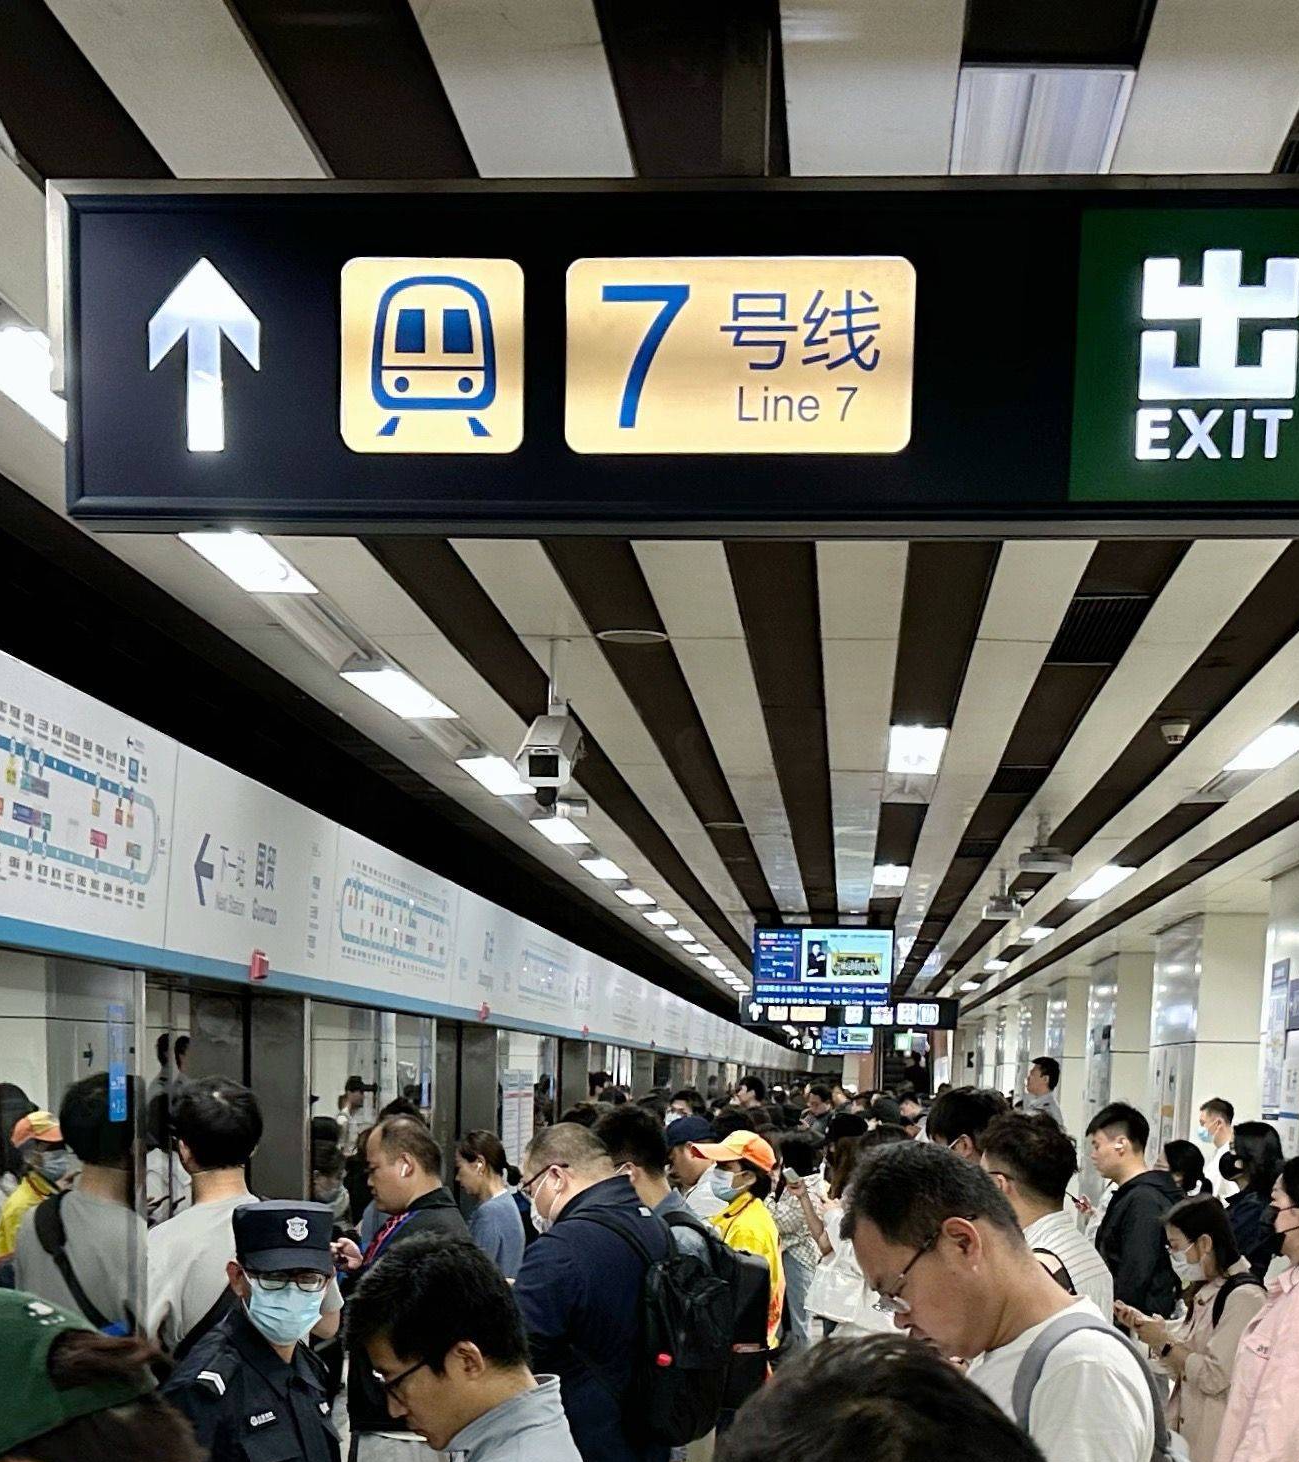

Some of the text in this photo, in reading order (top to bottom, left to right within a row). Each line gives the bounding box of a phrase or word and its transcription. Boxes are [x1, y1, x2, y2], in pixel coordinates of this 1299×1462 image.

[737, 385, 858, 422] Line 7
[1134, 407, 1294, 460] EXIT
[255, 842, 277, 891] 国贸
